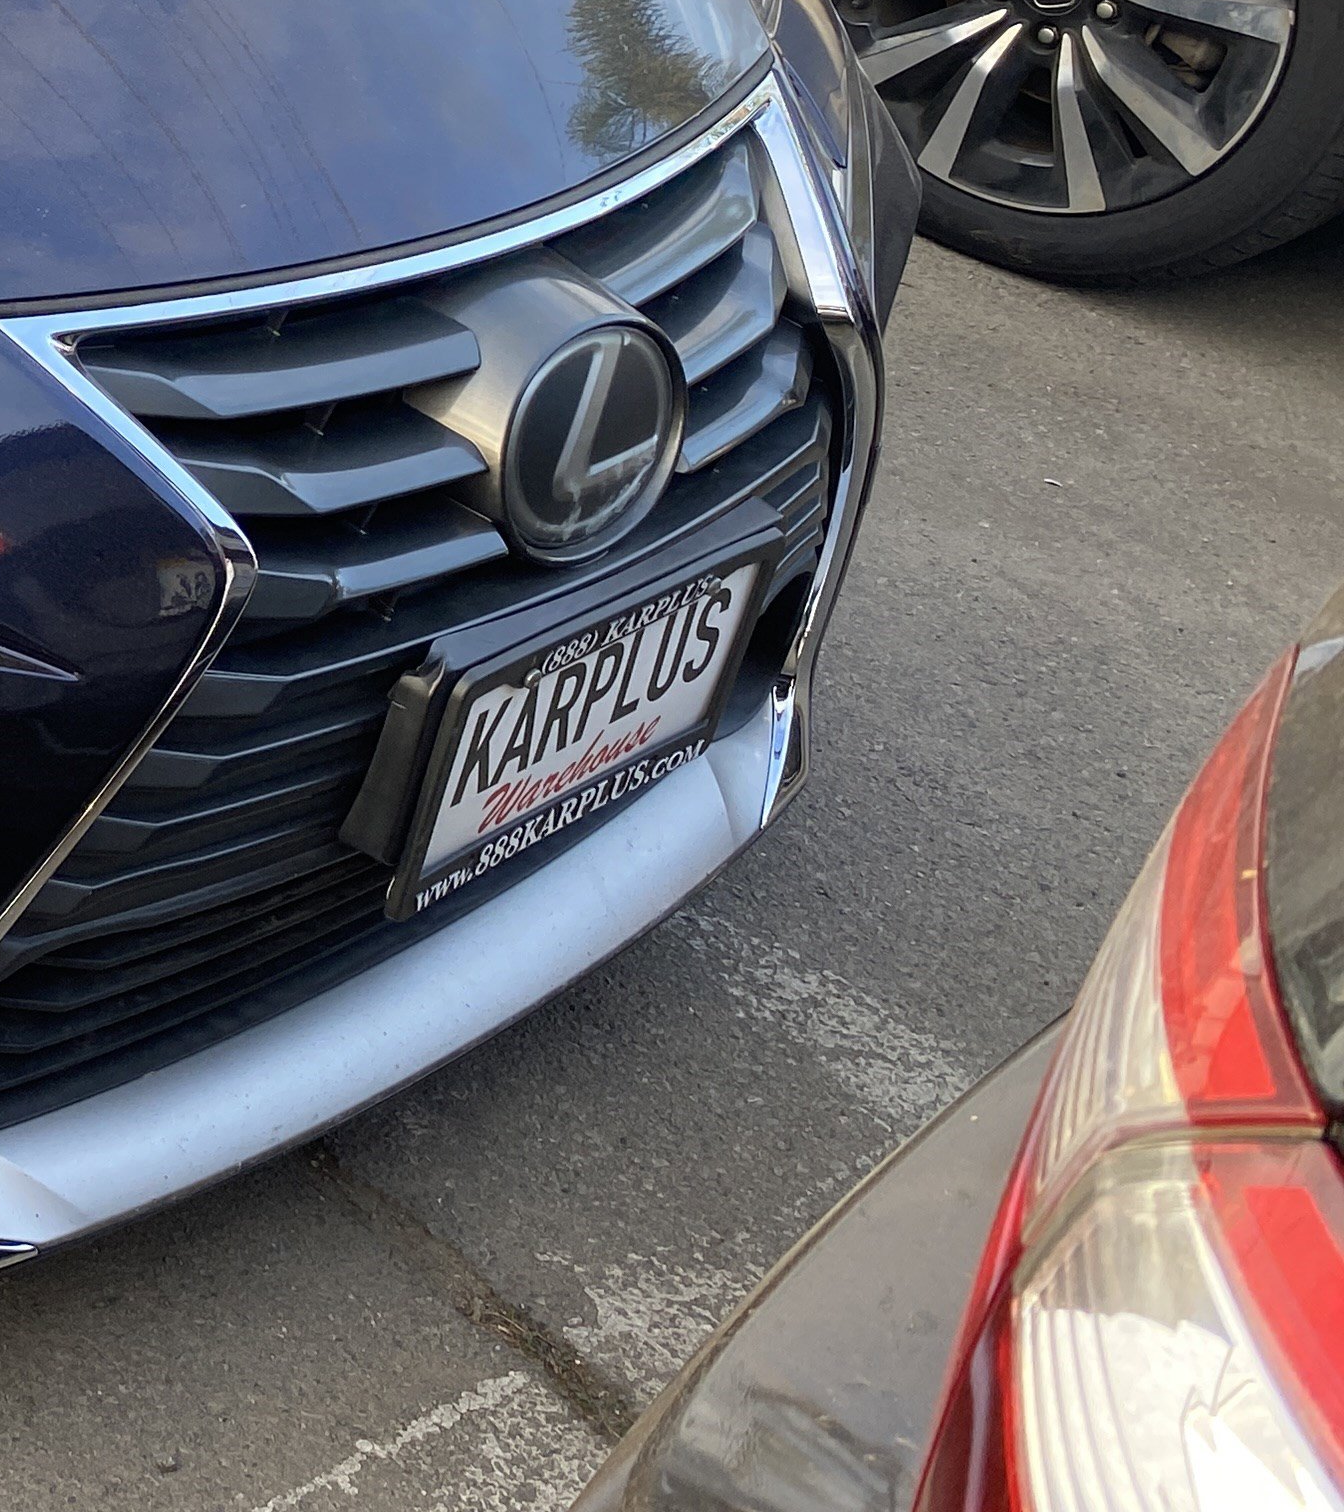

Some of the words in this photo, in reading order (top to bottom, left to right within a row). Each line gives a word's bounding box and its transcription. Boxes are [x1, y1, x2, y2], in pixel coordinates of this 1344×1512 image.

[542, 629, 599, 675] (888)
[601, 574, 714, 647] KARPLUS
[450, 587, 732, 809] KARPLUS
[477, 714, 661, 834] Warehouse
